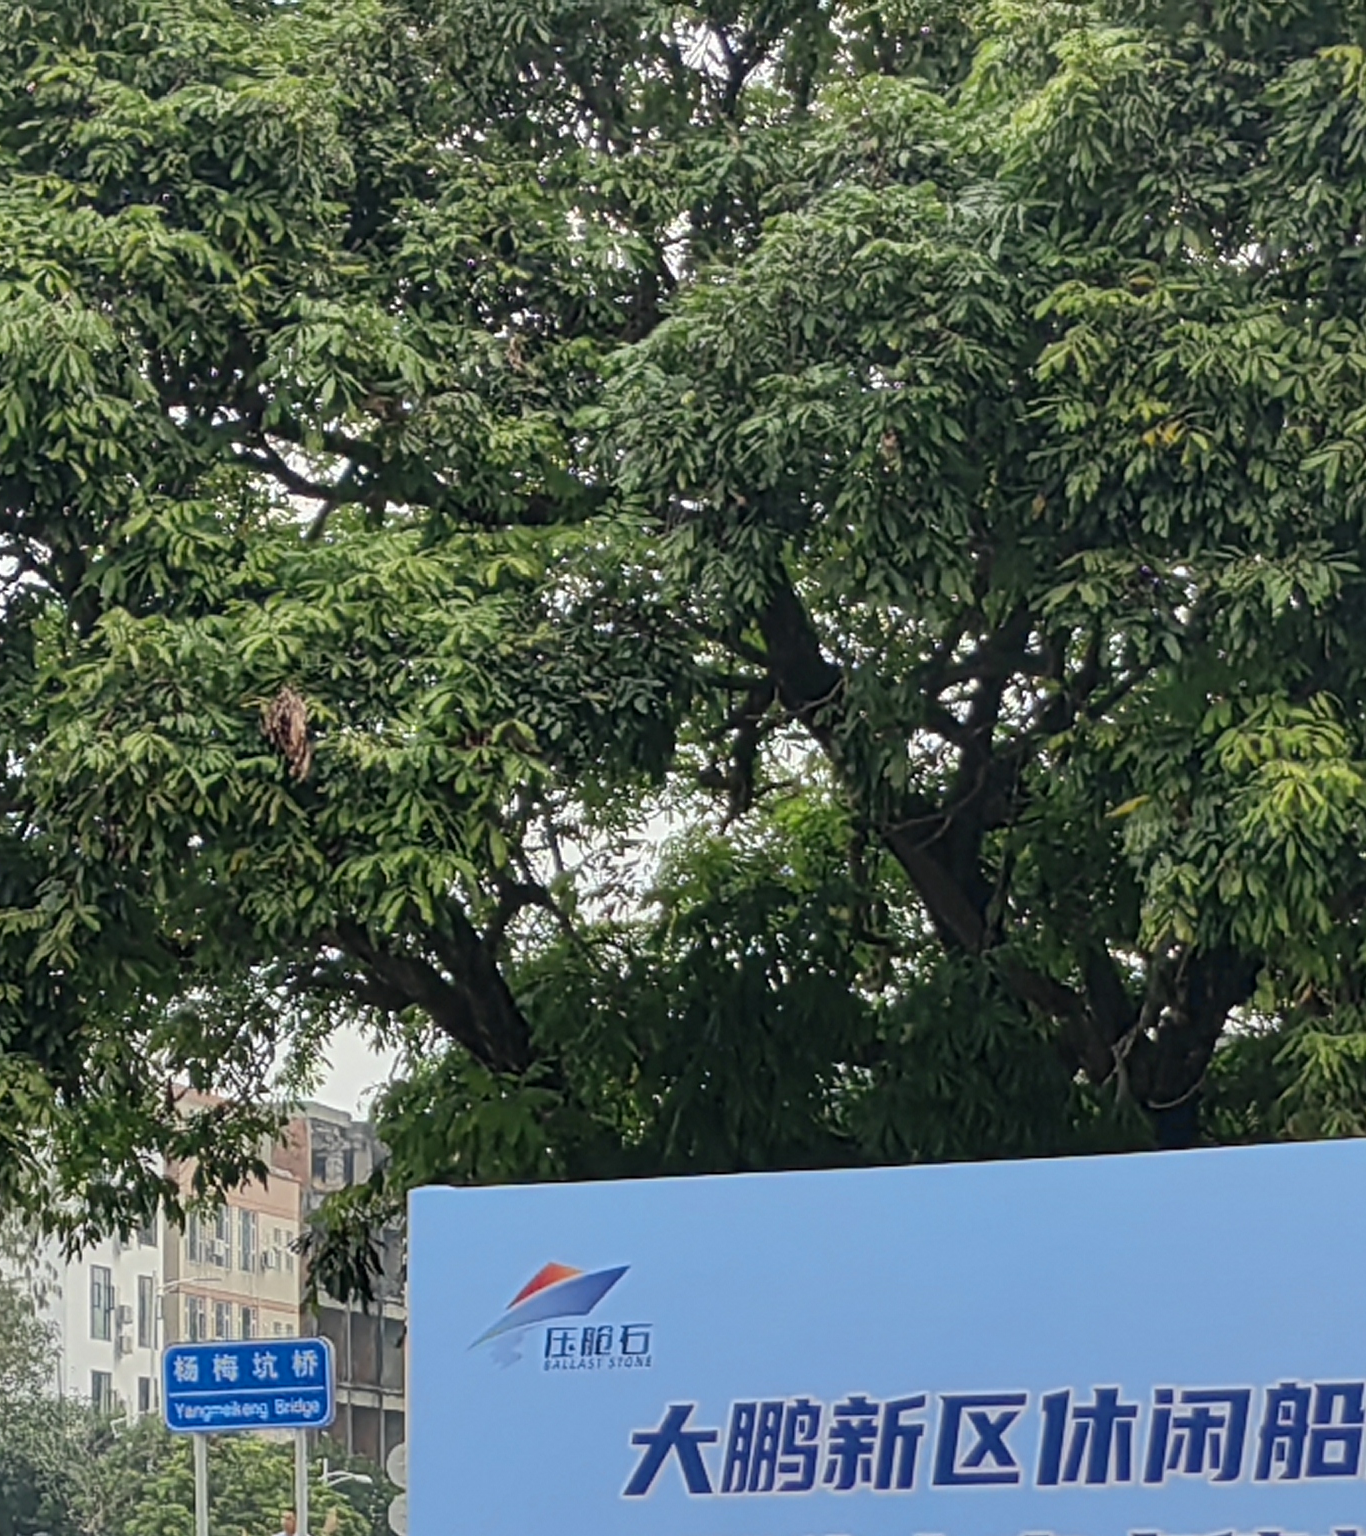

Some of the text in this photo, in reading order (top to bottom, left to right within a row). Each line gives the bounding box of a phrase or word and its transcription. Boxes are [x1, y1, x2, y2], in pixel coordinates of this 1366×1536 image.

[544, 1323, 653, 1359] 压舱石
[173, 1349, 318, 1383] 杨梅坑桥
[543, 1354, 653, 1371] BALLAST STONE
[274, 1397, 321, 1418] Bridge
